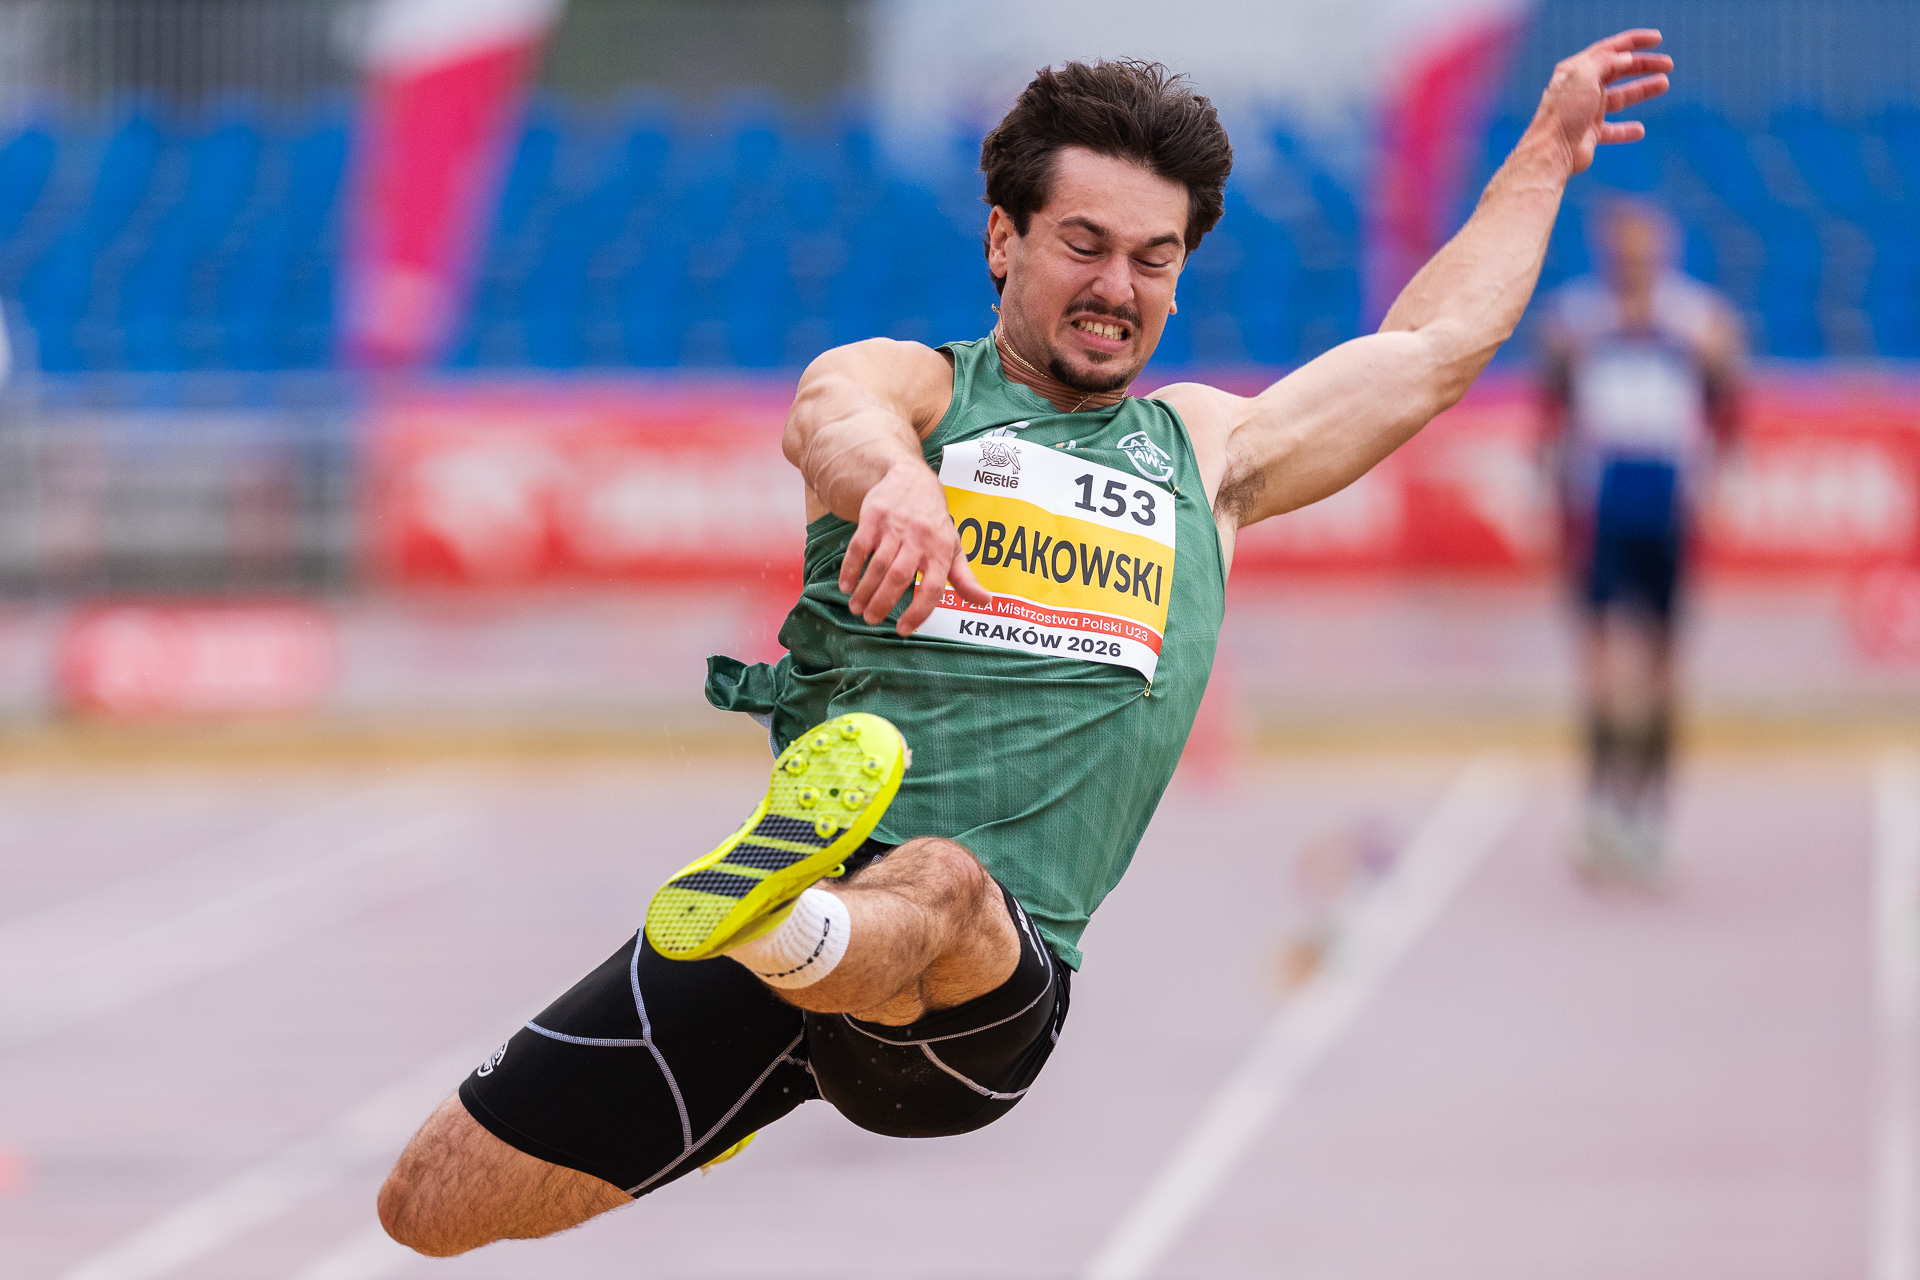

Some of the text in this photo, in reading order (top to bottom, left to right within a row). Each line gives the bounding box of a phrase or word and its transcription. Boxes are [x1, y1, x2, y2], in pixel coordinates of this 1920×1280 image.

[1074, 473, 1157, 527] 153
[949, 513, 1163, 607] OBAKOWSKI
[958, 619, 1122, 658] KRAKÓW 2026
[997, 600, 1079, 627] Mistrzostwa
[1082, 617, 1122, 634] Polski
[1125, 624, 1149, 642] U23
